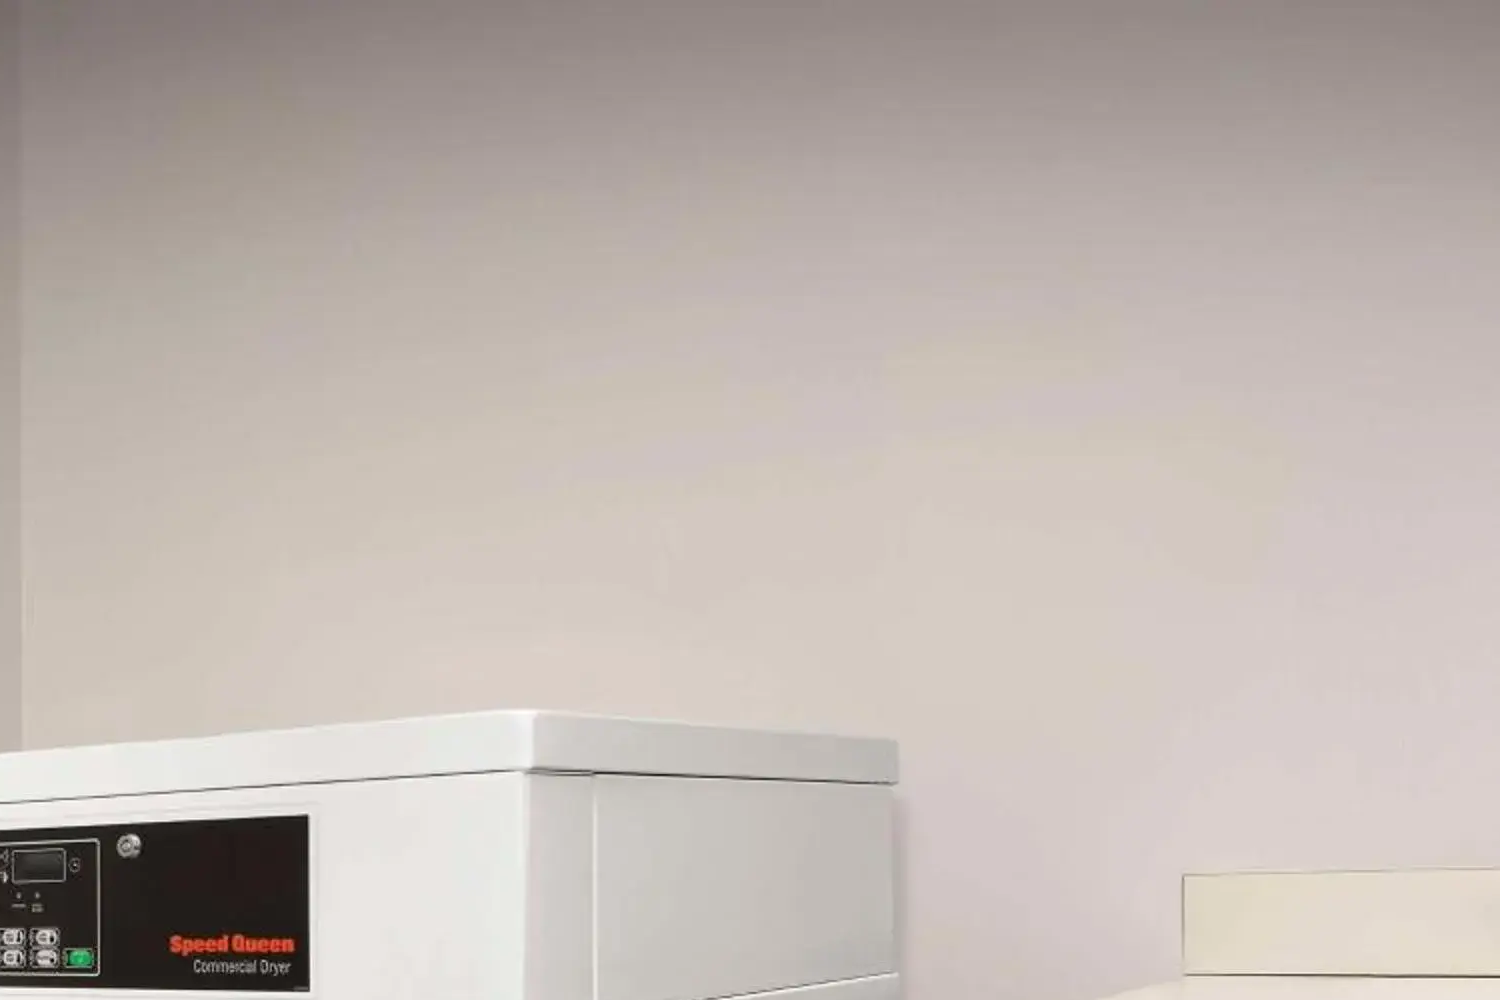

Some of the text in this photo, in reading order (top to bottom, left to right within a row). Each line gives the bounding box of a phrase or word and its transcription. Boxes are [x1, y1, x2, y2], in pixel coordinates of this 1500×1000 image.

[170, 934, 295, 956] Speed Queen
[193, 959, 291, 977] Commercial Dryer
